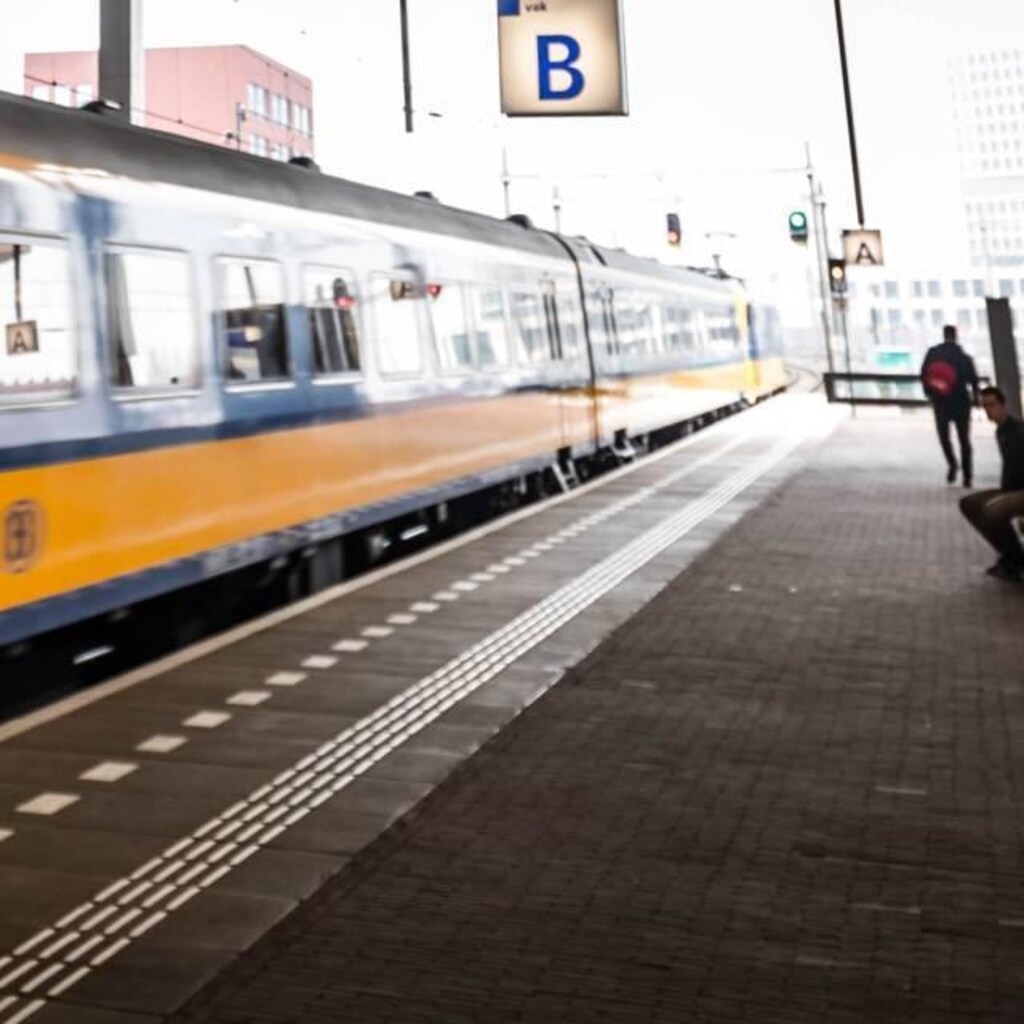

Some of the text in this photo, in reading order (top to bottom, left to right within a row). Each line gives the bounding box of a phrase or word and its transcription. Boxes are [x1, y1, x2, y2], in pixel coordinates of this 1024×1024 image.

[525, 1, 548, 13] vak
[536, 34, 586, 101] B
[855, 242, 877, 264] A
